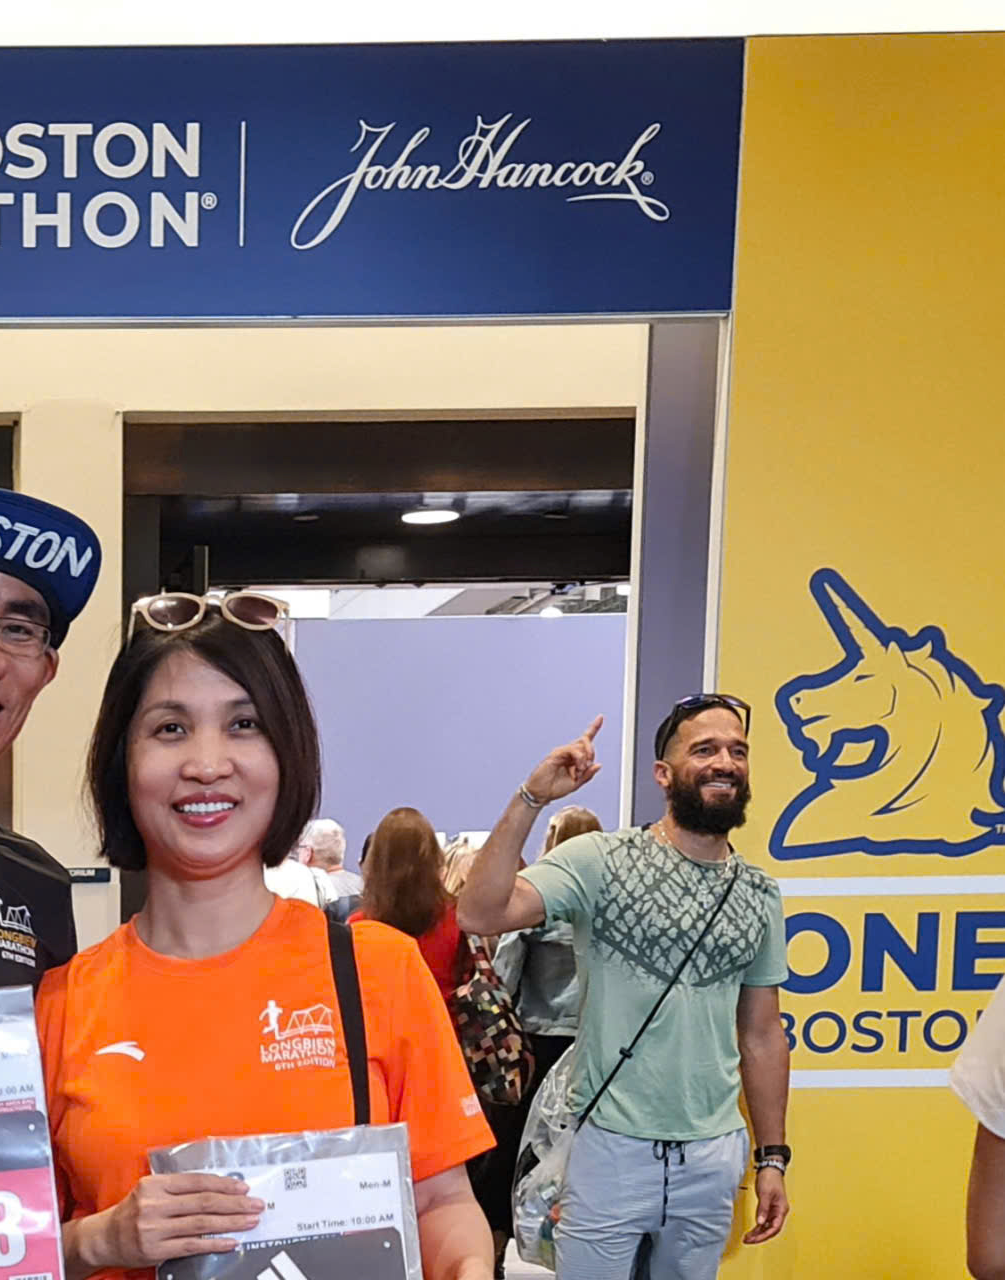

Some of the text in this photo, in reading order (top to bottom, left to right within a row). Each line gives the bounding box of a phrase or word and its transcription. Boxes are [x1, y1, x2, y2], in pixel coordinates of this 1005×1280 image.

[291, 119, 441, 250] John
[779, 911, 1005, 995] ONE
[779, 1009, 983, 1053] OSTO
[260, 1038, 335, 1054] LONGBIEN
[261, 1045, 335, 1063] MARATHON
[19, 1084, 34, 1093] AM
[297, 1222, 319, 1231] Start
[351, 1216, 376, 1225] 10:00
[379, 1213, 394, 1223] AM
